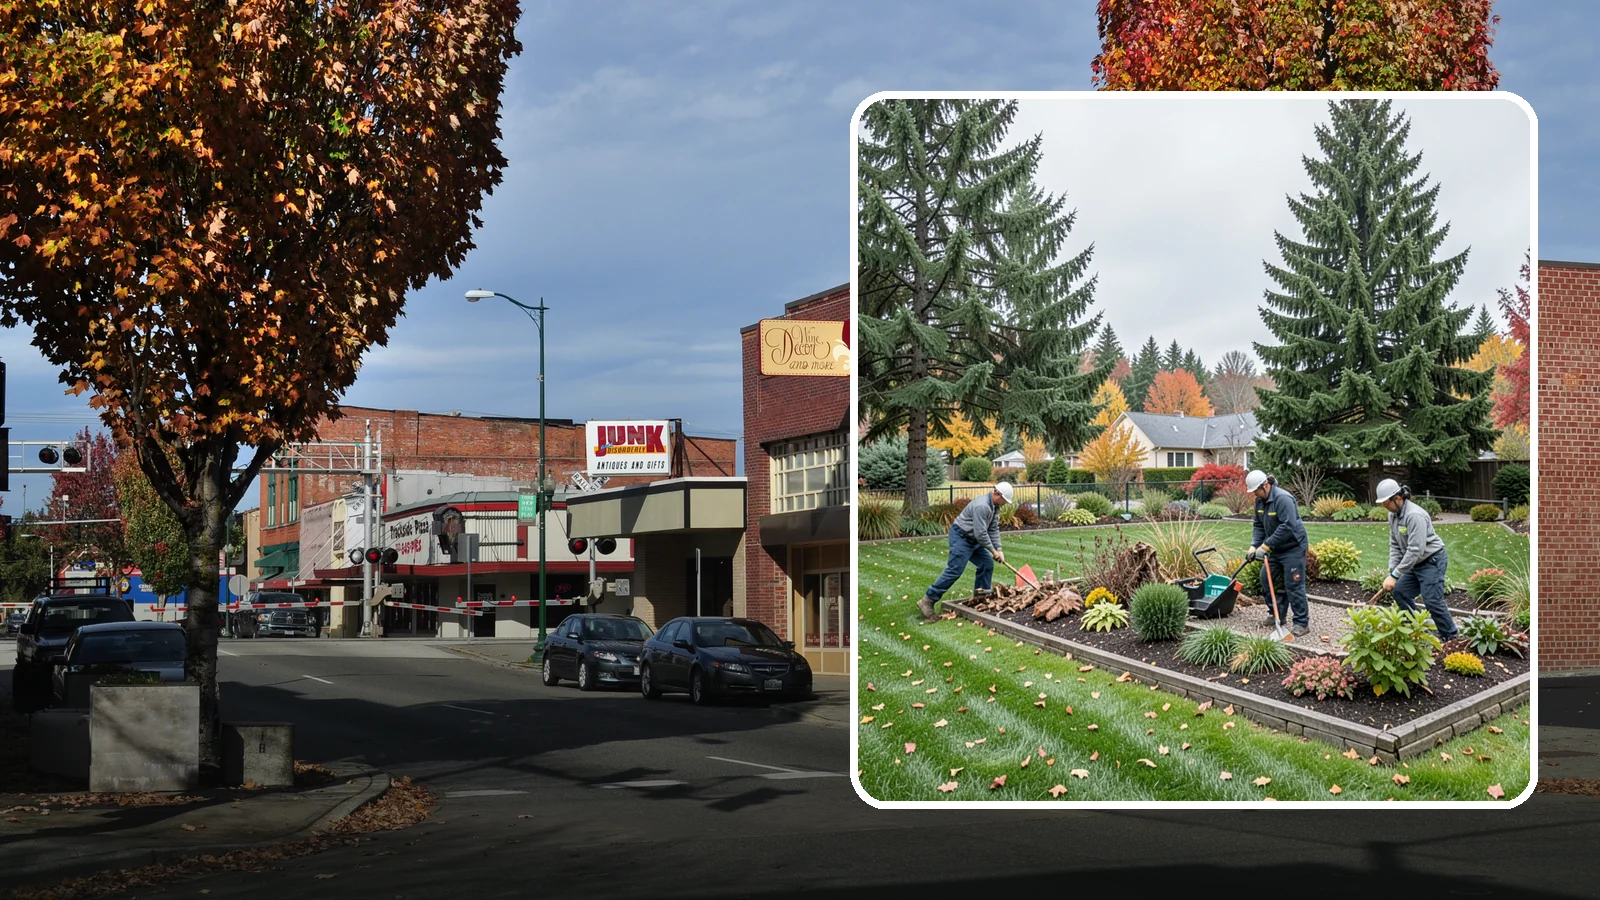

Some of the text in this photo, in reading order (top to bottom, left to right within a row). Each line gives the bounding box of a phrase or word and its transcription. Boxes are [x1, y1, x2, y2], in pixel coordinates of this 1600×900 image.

[595, 425, 665, 457] JUNK
[607, 446, 646, 454] DISORDERLY
[597, 460, 665, 470] ANTIQUES AND GIFTS
[390, 521, 413, 539] Trackside
